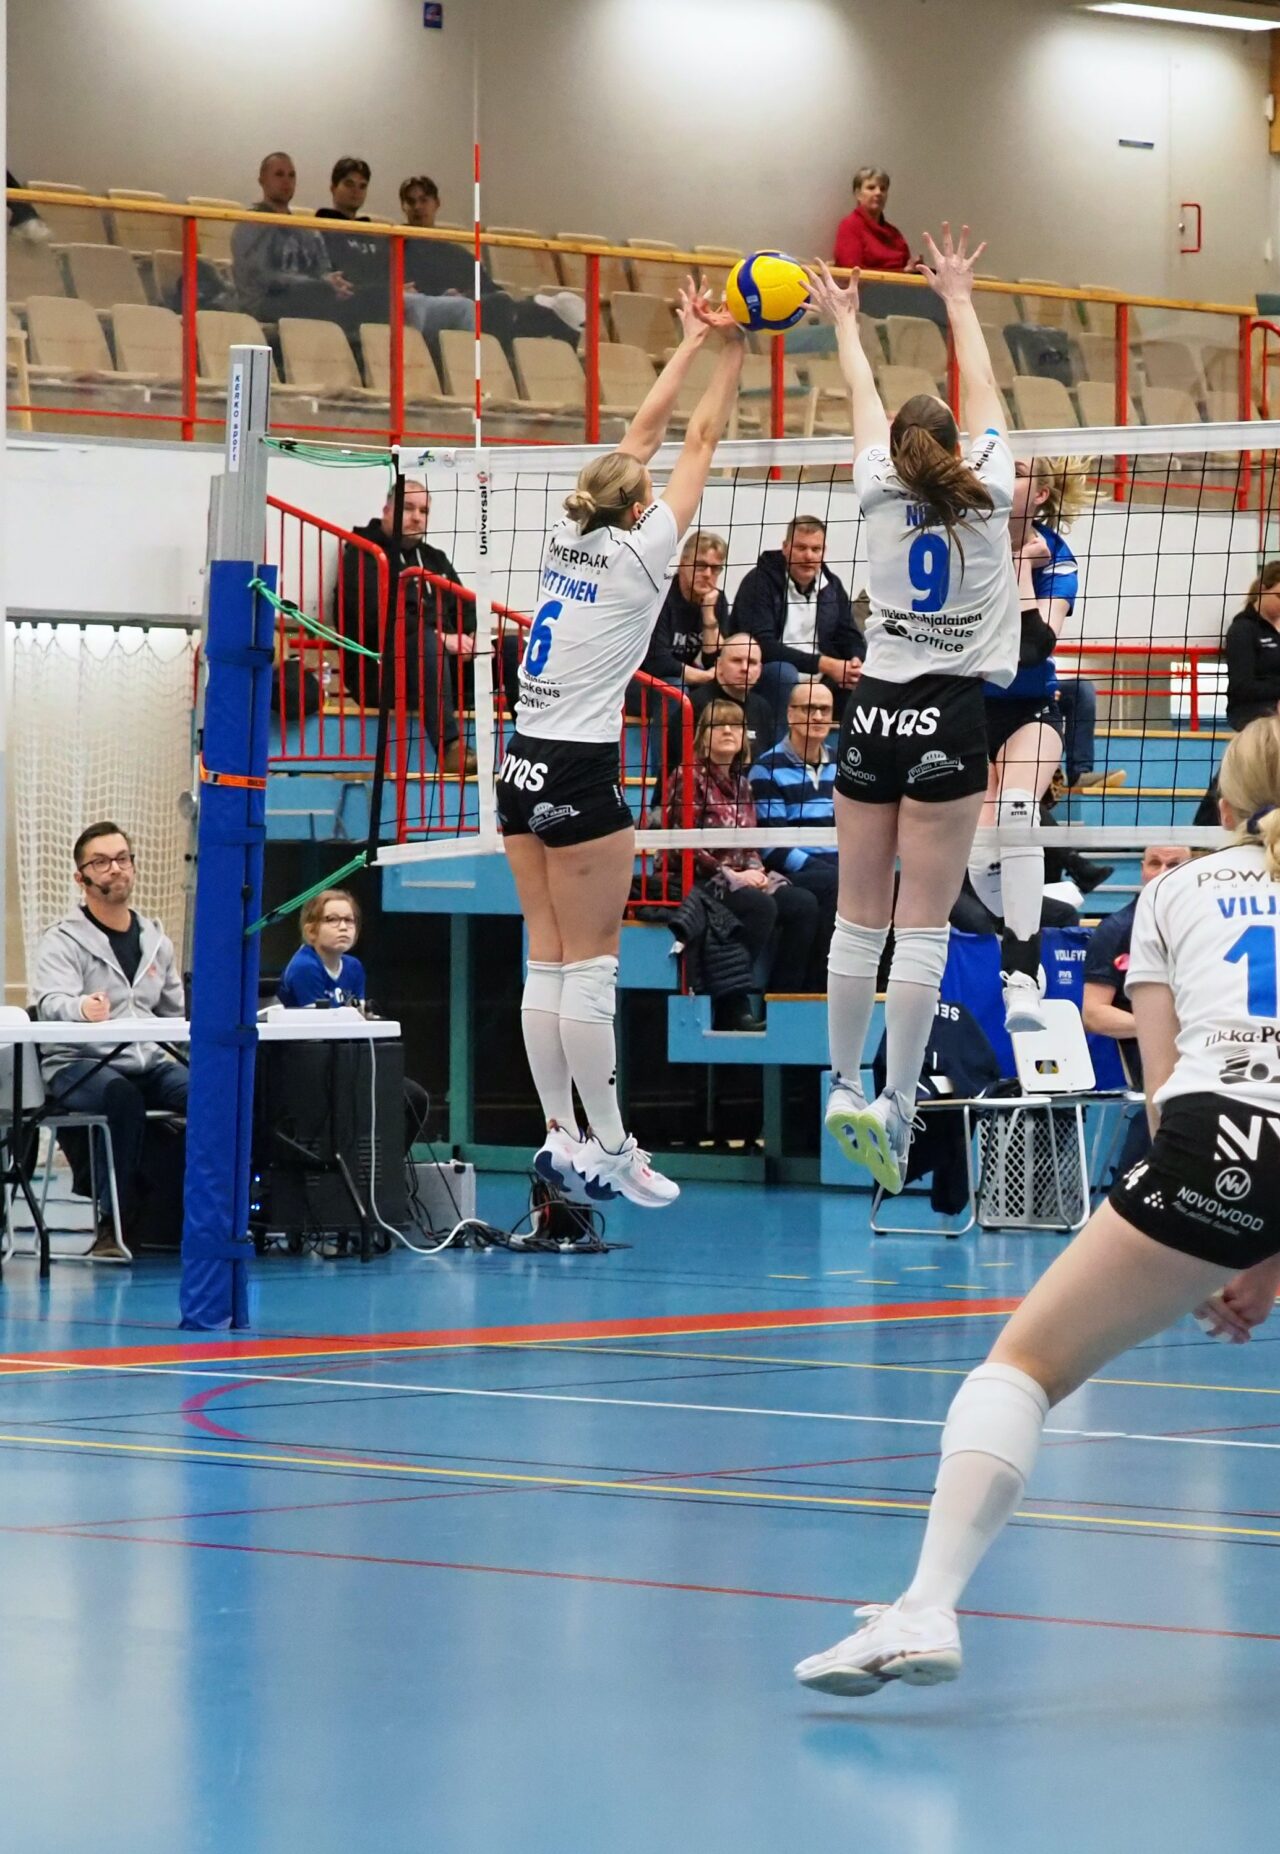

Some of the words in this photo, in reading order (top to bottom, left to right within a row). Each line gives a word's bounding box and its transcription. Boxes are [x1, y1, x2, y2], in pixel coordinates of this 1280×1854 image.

[479, 485, 488, 555] Universal
[908, 533, 951, 613] 9
[525, 600, 564, 677] 6
[851, 705, 941, 737] NYQS
[1177, 1186, 1264, 1231] NOVOWOOD
